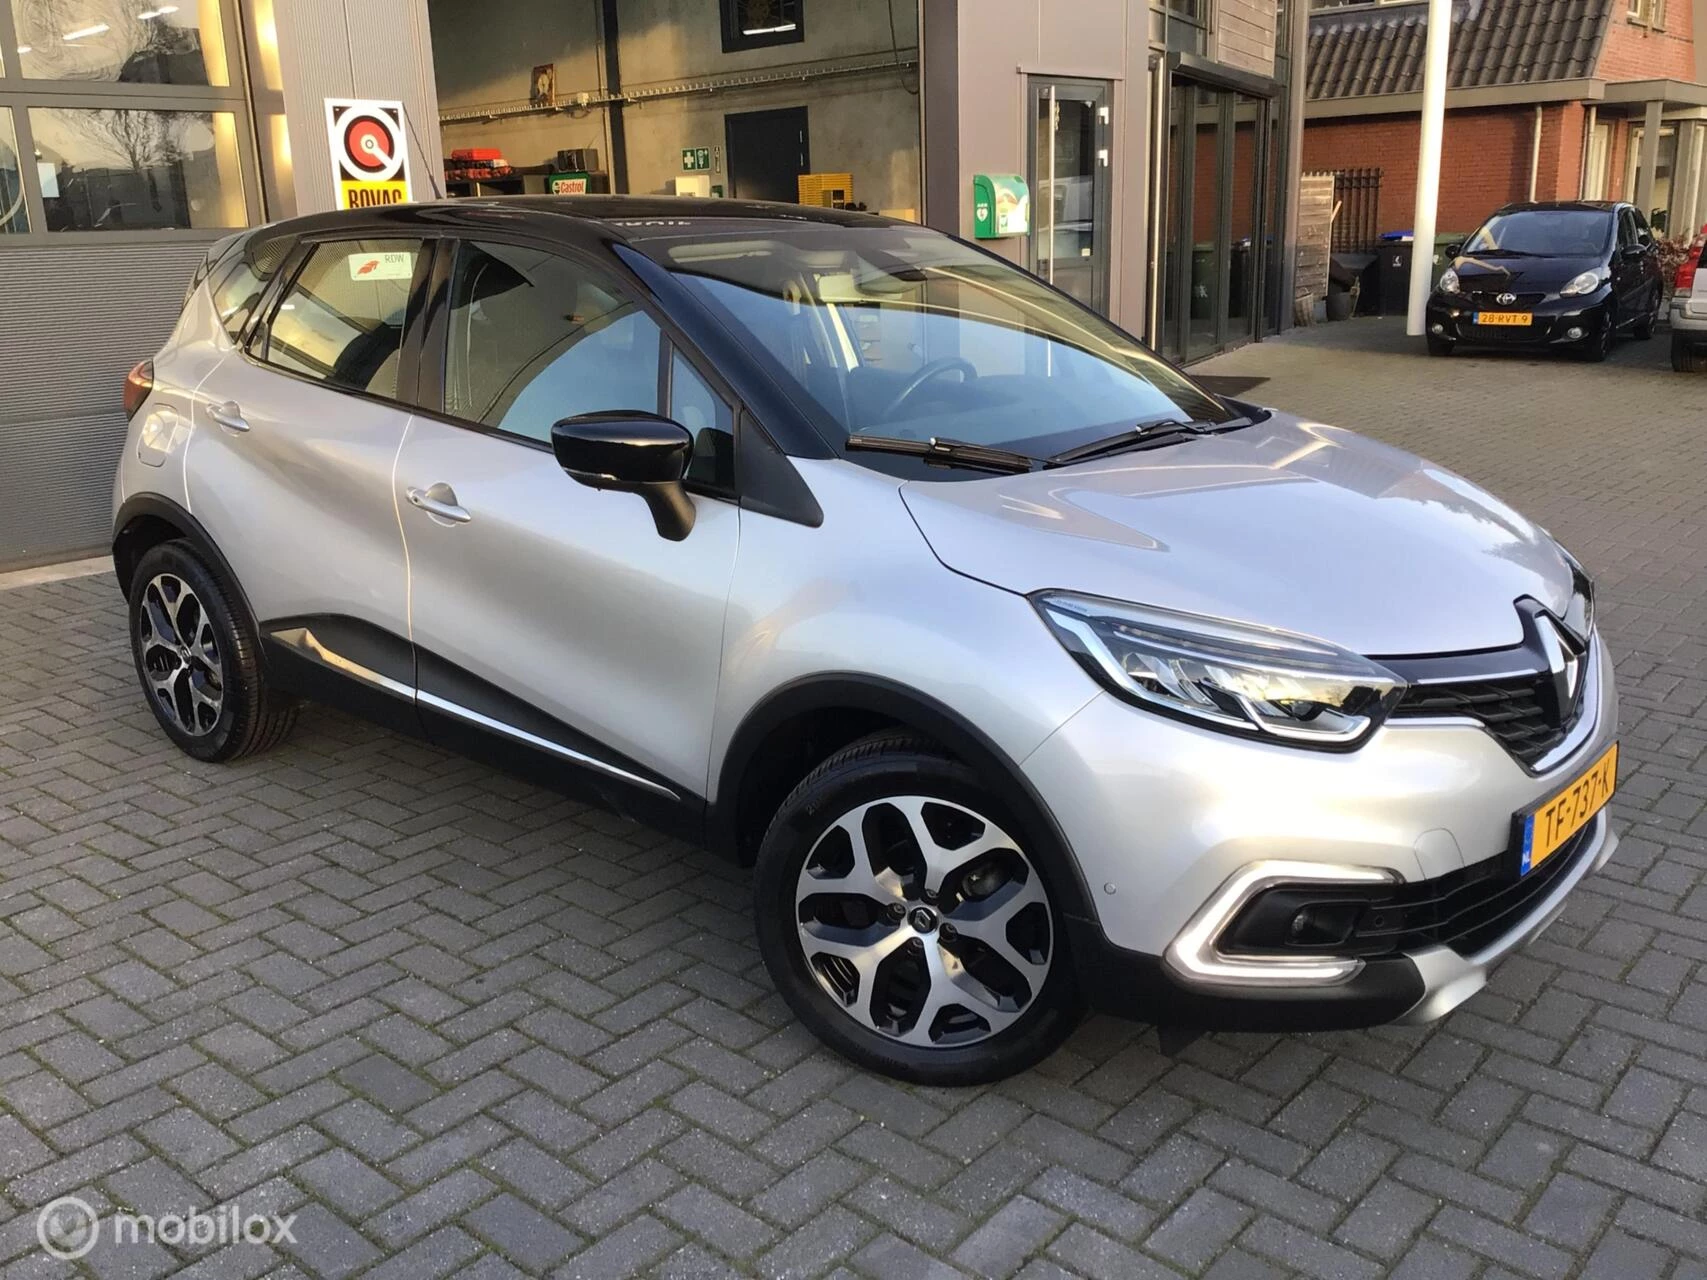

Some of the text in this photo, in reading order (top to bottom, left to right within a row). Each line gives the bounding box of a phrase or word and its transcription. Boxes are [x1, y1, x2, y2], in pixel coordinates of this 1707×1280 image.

[560, 181, 584, 193] Castrol
[384, 254, 404, 264] RDW
[1545, 758, 1610, 848] TF-737-K
